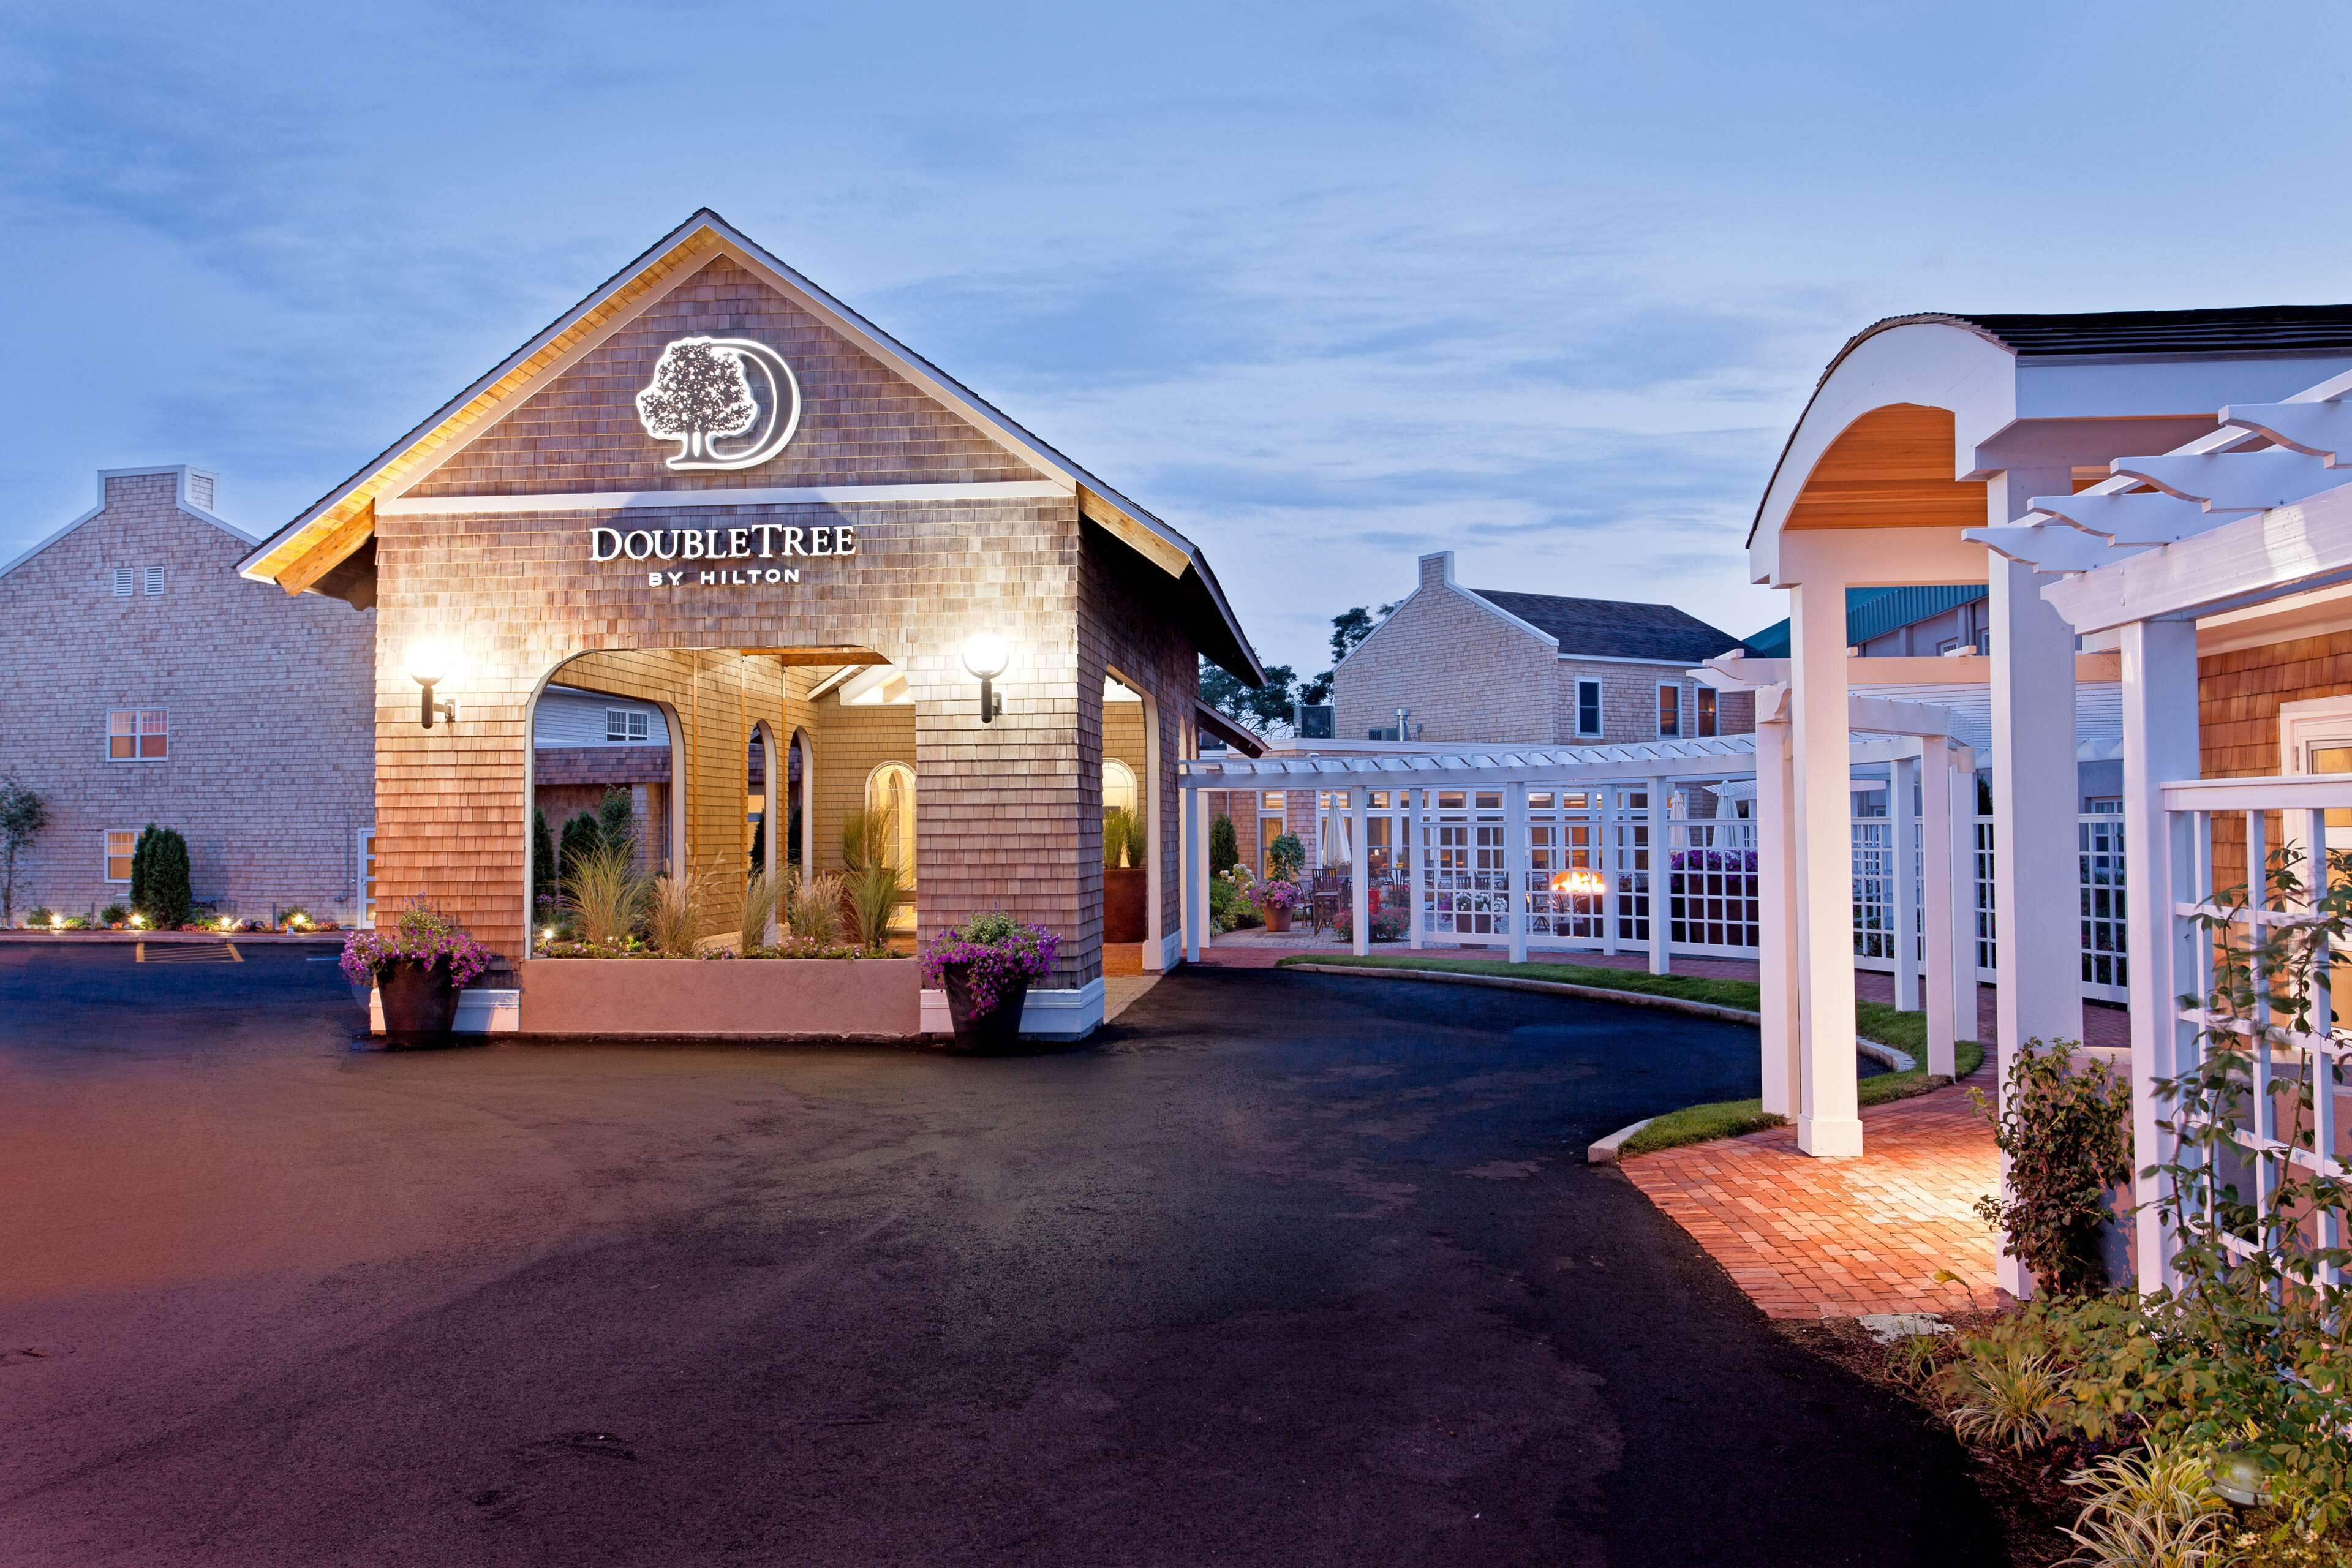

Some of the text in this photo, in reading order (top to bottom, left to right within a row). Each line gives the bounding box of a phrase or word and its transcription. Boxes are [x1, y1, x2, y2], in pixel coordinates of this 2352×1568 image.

[589, 524, 856, 561] DOUBLETREE
[649, 568, 799, 587] BY HILTON
